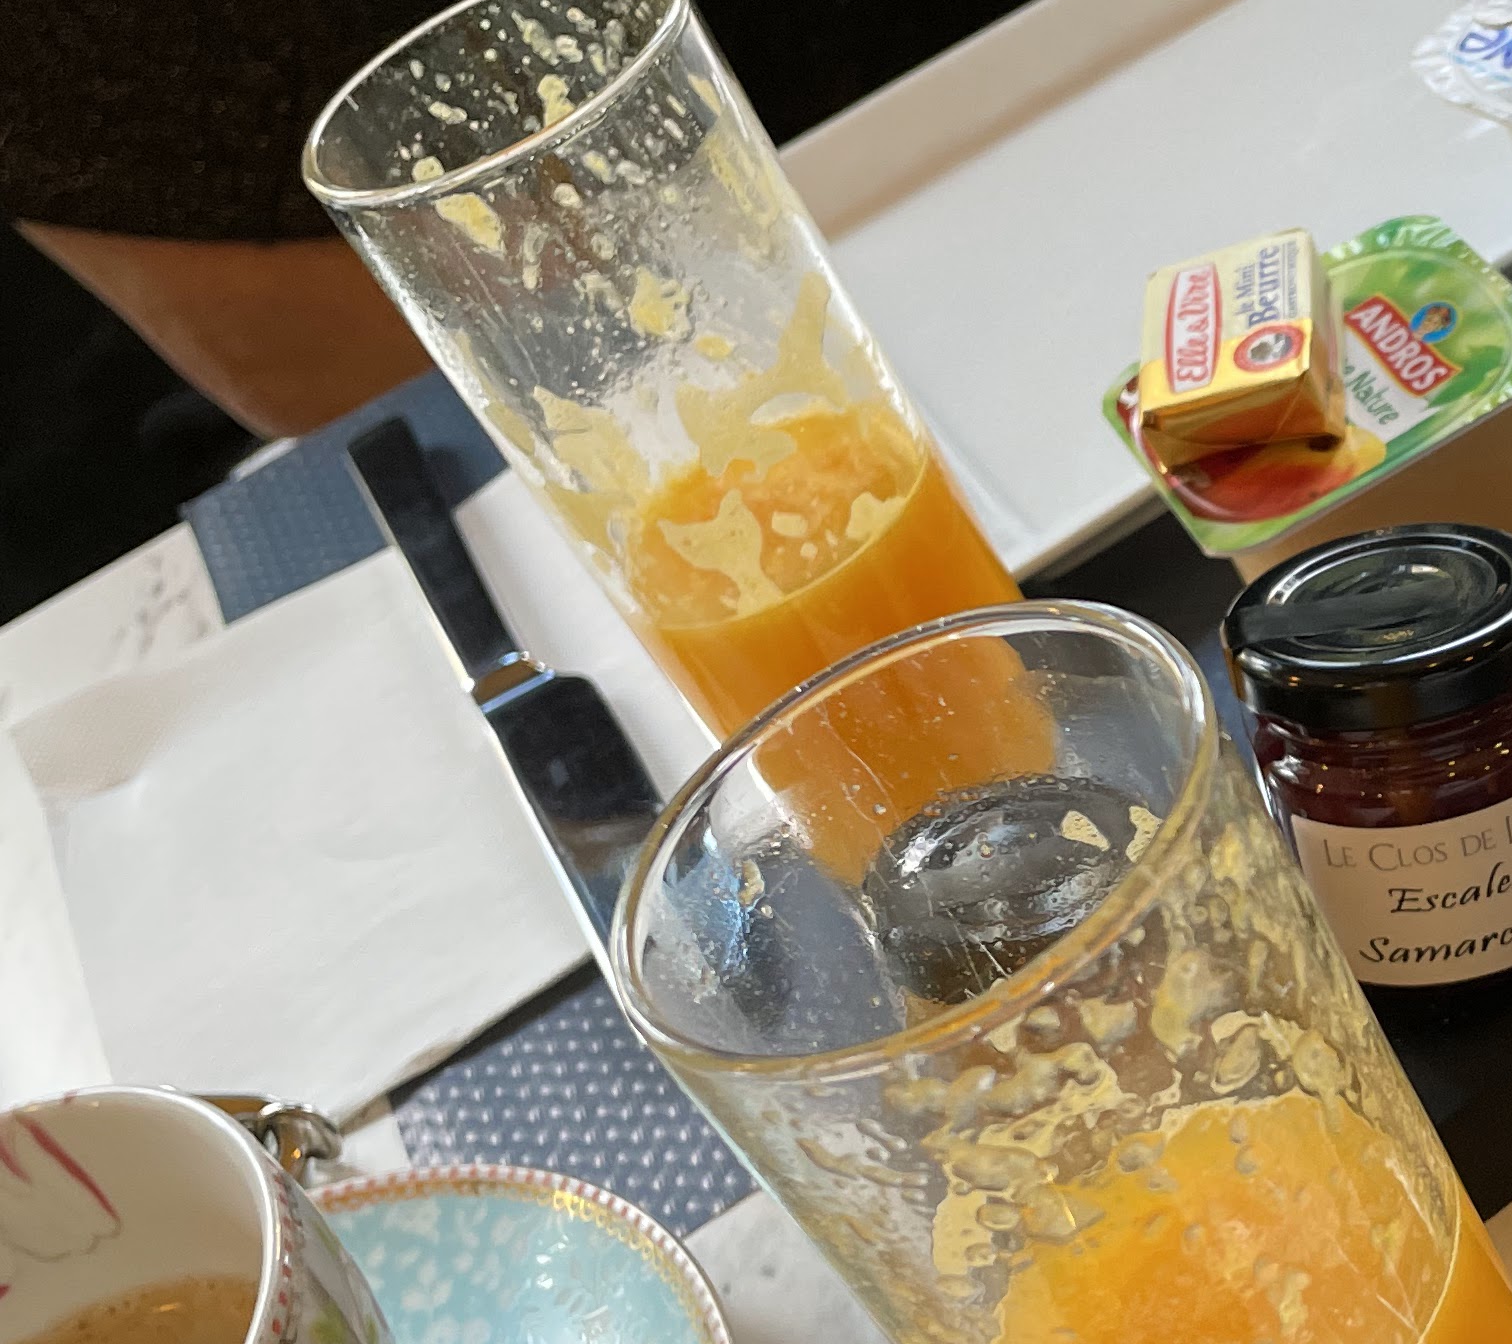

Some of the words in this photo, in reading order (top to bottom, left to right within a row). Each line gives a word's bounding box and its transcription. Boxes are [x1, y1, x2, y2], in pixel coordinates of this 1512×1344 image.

[1249, 245, 1281, 327] Beurre
[1350, 302, 1448, 393] ANDROS
[1348, 369, 1400, 427] Nature
[1323, 839, 1356, 868] LE
[1368, 842, 1448, 872] CLOS
[1460, 828, 1497, 858] DE
[1388, 861, 1512, 914] Escale
